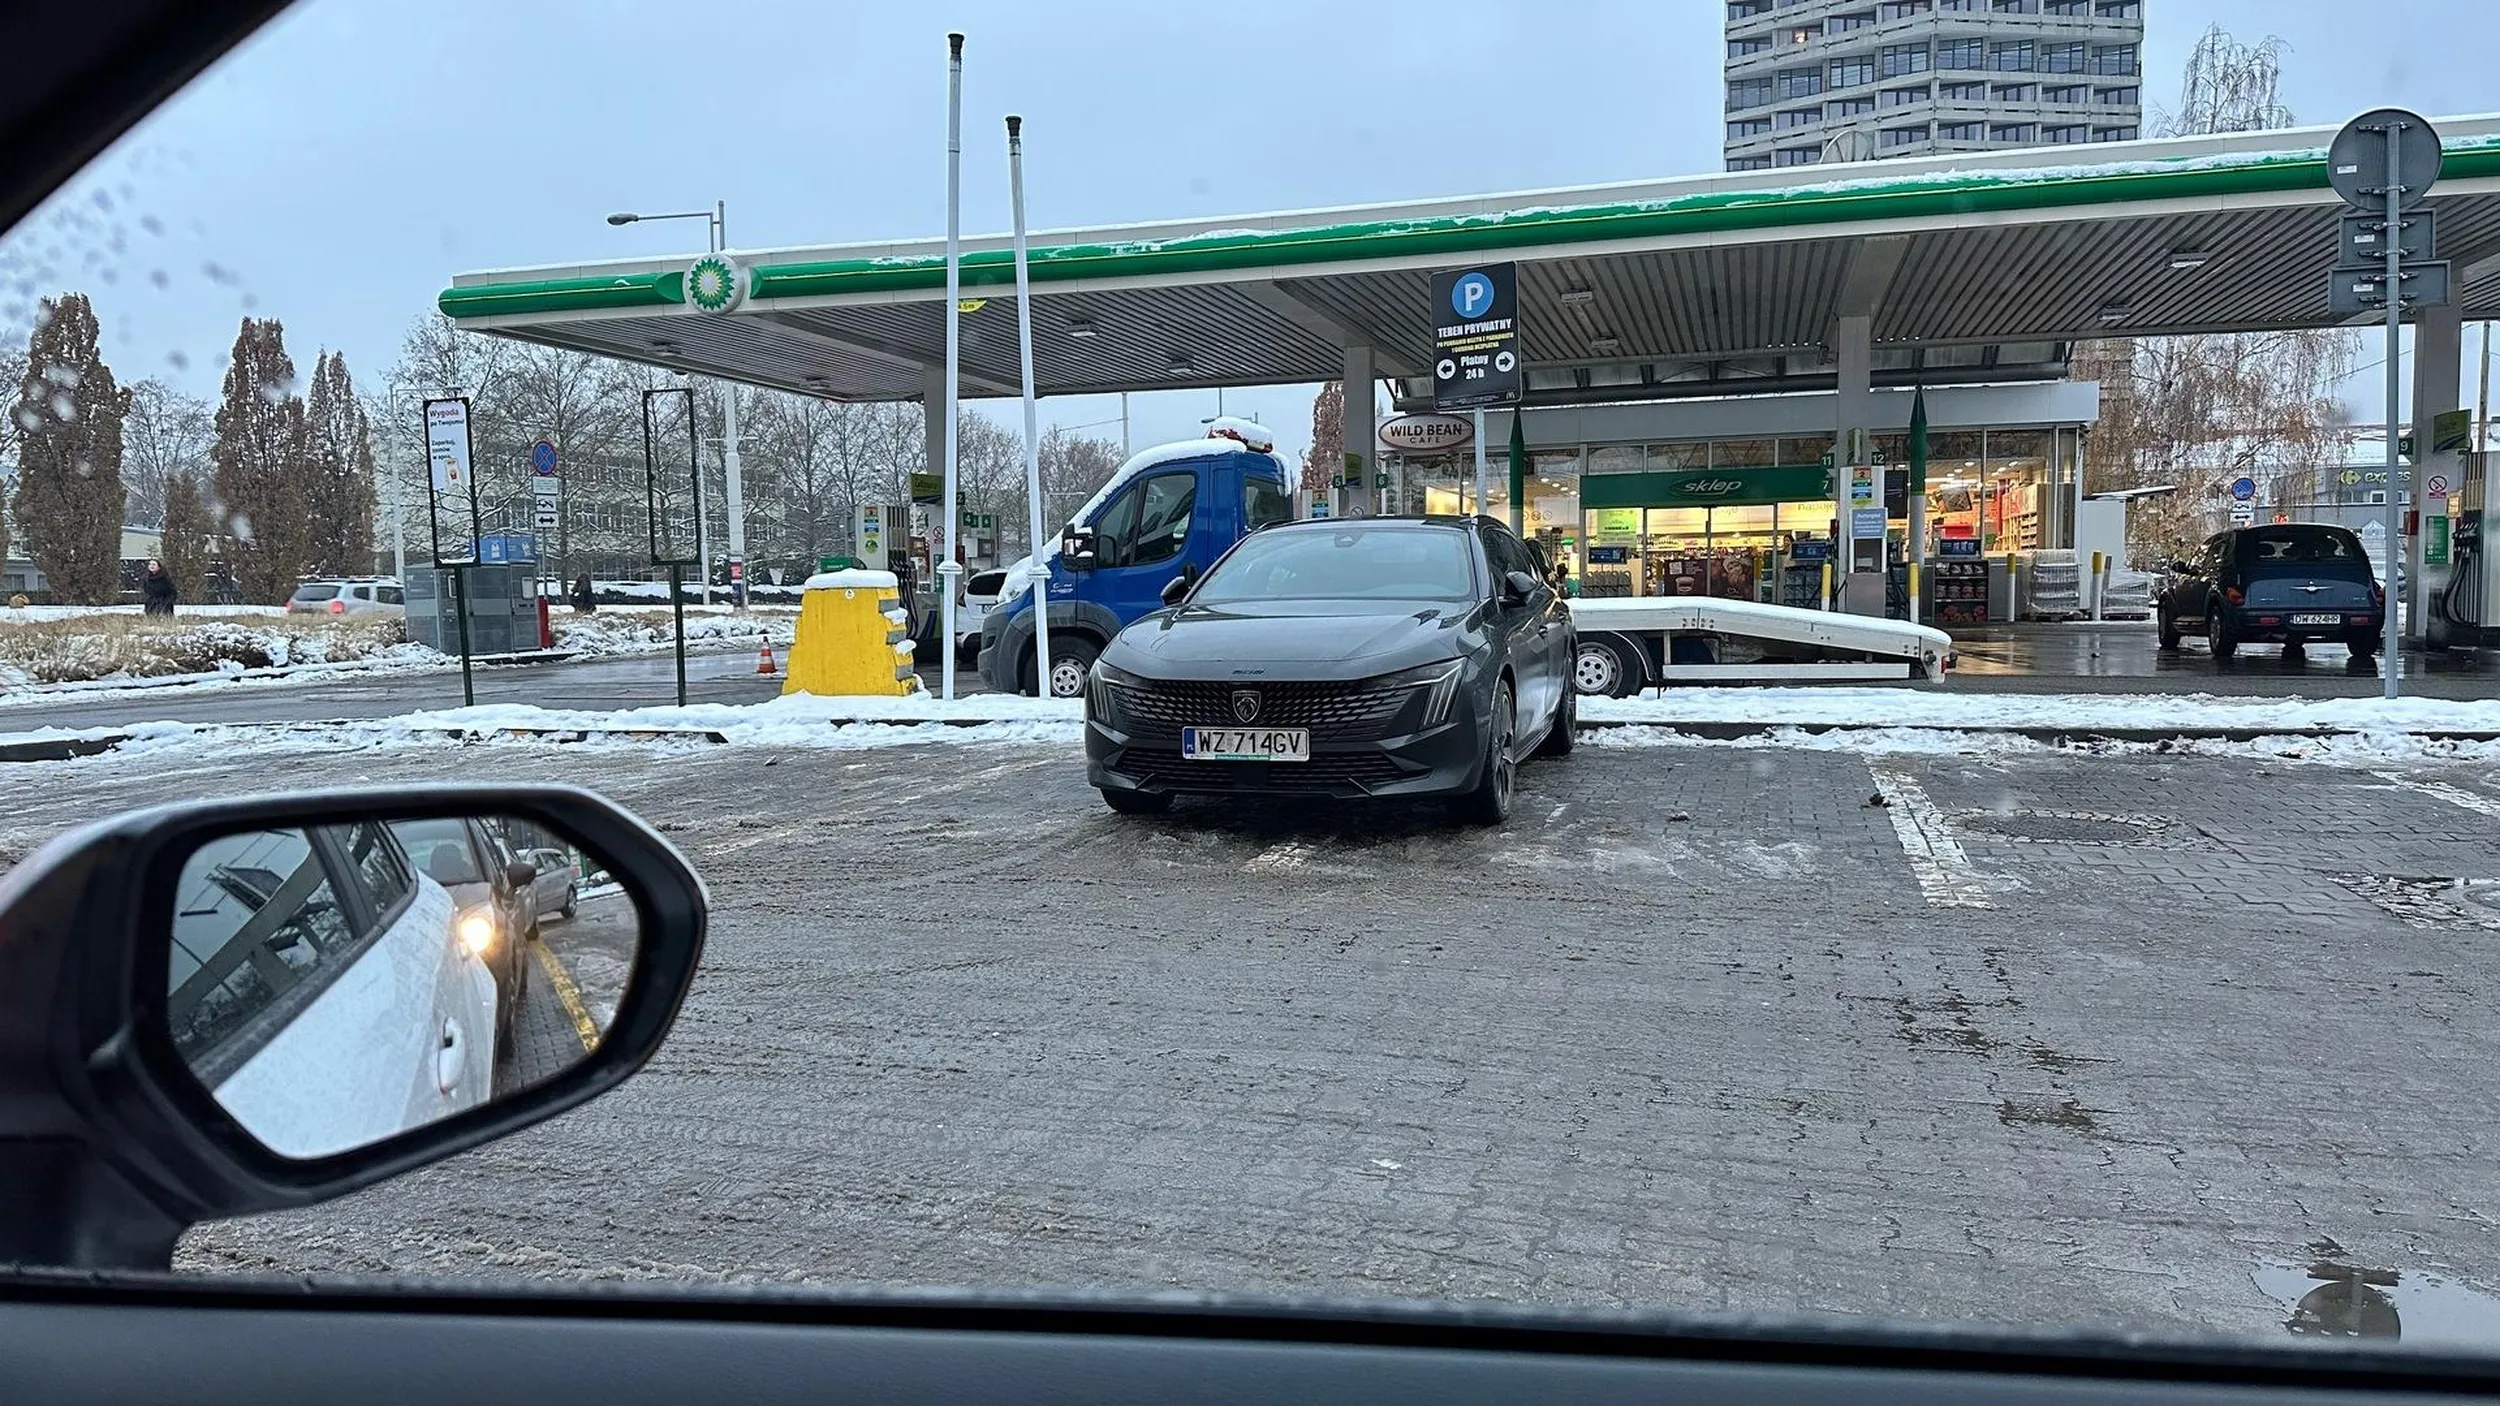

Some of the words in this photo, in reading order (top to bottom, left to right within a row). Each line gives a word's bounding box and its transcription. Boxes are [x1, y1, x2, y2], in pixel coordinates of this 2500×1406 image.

[1464, 282, 1484, 312] P
[1437, 325, 1463, 338] TEREN
[1464, 318, 1512, 335] PRYWATNY
[1465, 368, 1477, 379] 24
[429, 409, 459, 418] Wygoda
[1390, 425, 1423, 437] WILD
[1426, 424, 1462, 436] BEAN
[2401, 441, 2408, 450] 9
[1822, 456, 1832, 466] 11
[1873, 454, 1885, 464] 12
[1378, 476, 1384, 485] 6
[1823, 480, 1829, 489] 7
[1685, 479, 1742, 495] sklep
[1199, 731, 1225, 753] WZ
[1234, 732, 1300, 754] 714GV
